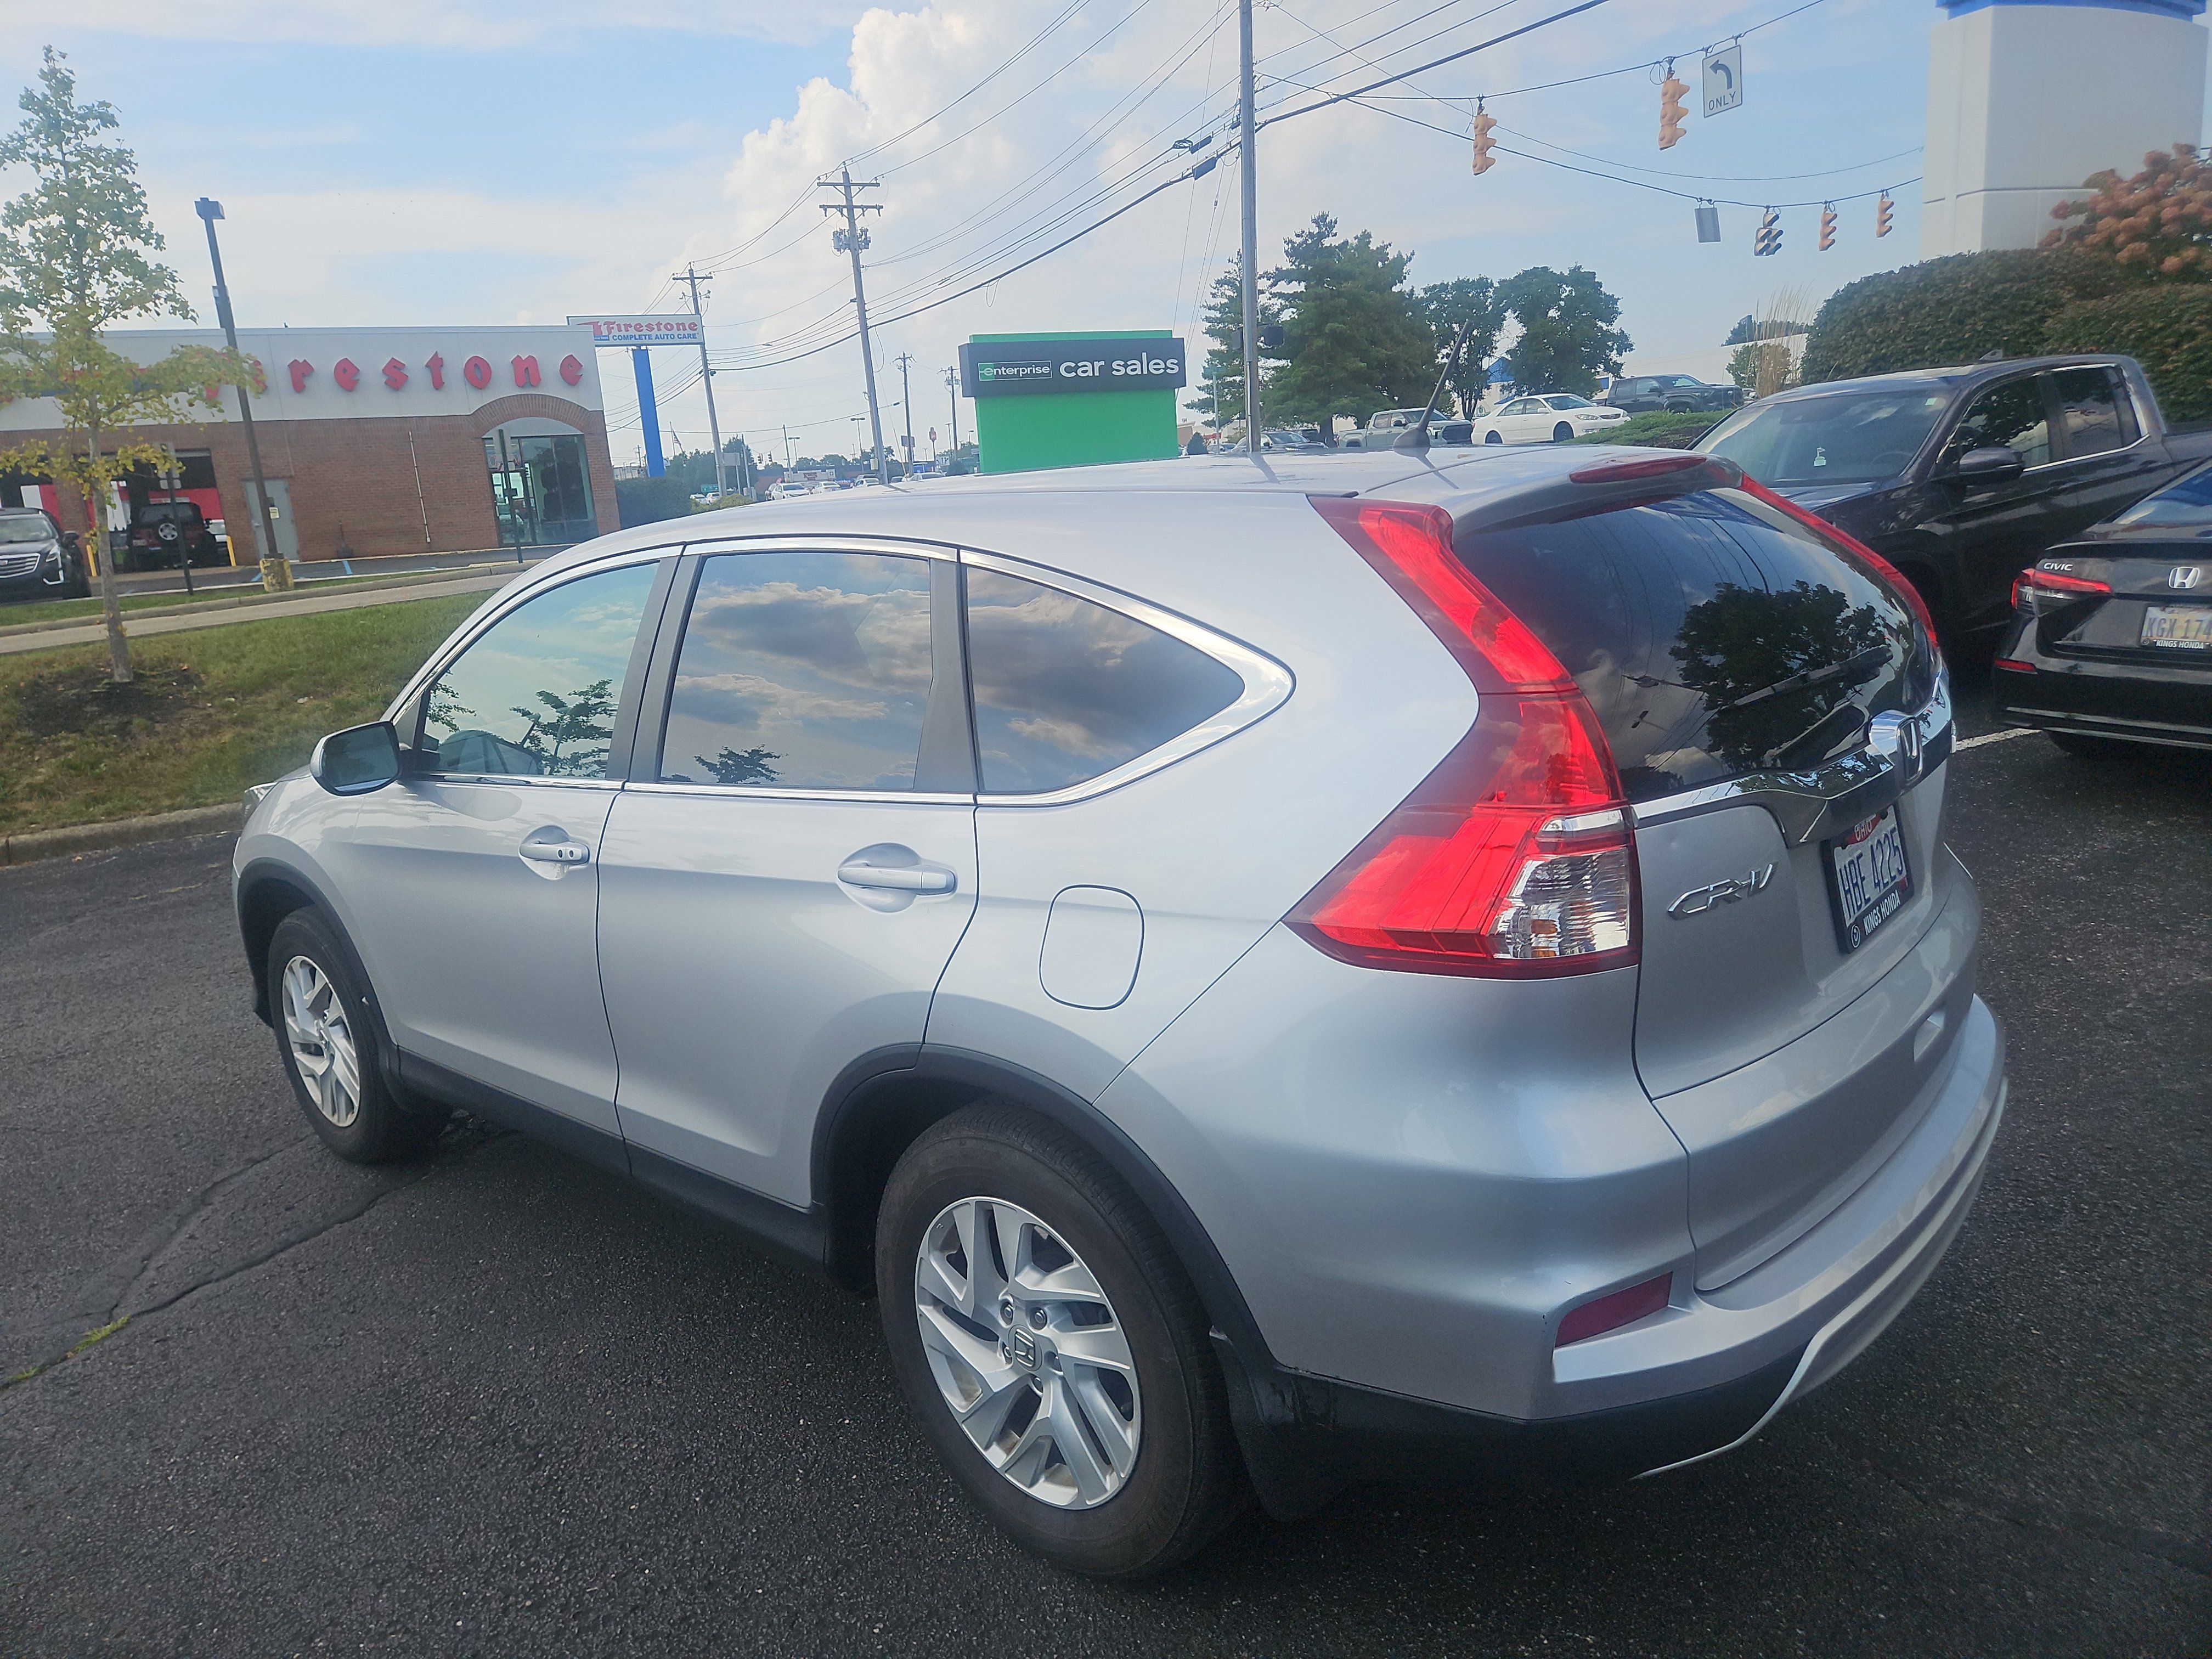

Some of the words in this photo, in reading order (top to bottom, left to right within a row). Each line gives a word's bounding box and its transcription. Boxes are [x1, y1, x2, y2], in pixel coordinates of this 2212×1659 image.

[1708, 91, 1736, 111] ONLY
[603, 320, 698, 335] Firestone
[196, 350, 584, 402] restone
[981, 364, 1051, 377] enterprise
[1059, 359, 1105, 377] car
[1111, 352, 1180, 376] sales
[2043, 562, 2073, 572] CIVIC
[2145, 617, 2177, 639] KGX
[2155, 640, 2177, 648] KINGS
[2178, 641, 2204, 650] HONDA
[1838, 851, 1871, 920] HBE
[1869, 825, 1904, 893] 4225
[1667, 863, 1774, 914] CR-V
[1863, 906, 1882, 935] KINGS
[1880, 889, 1901, 916] HONDA
